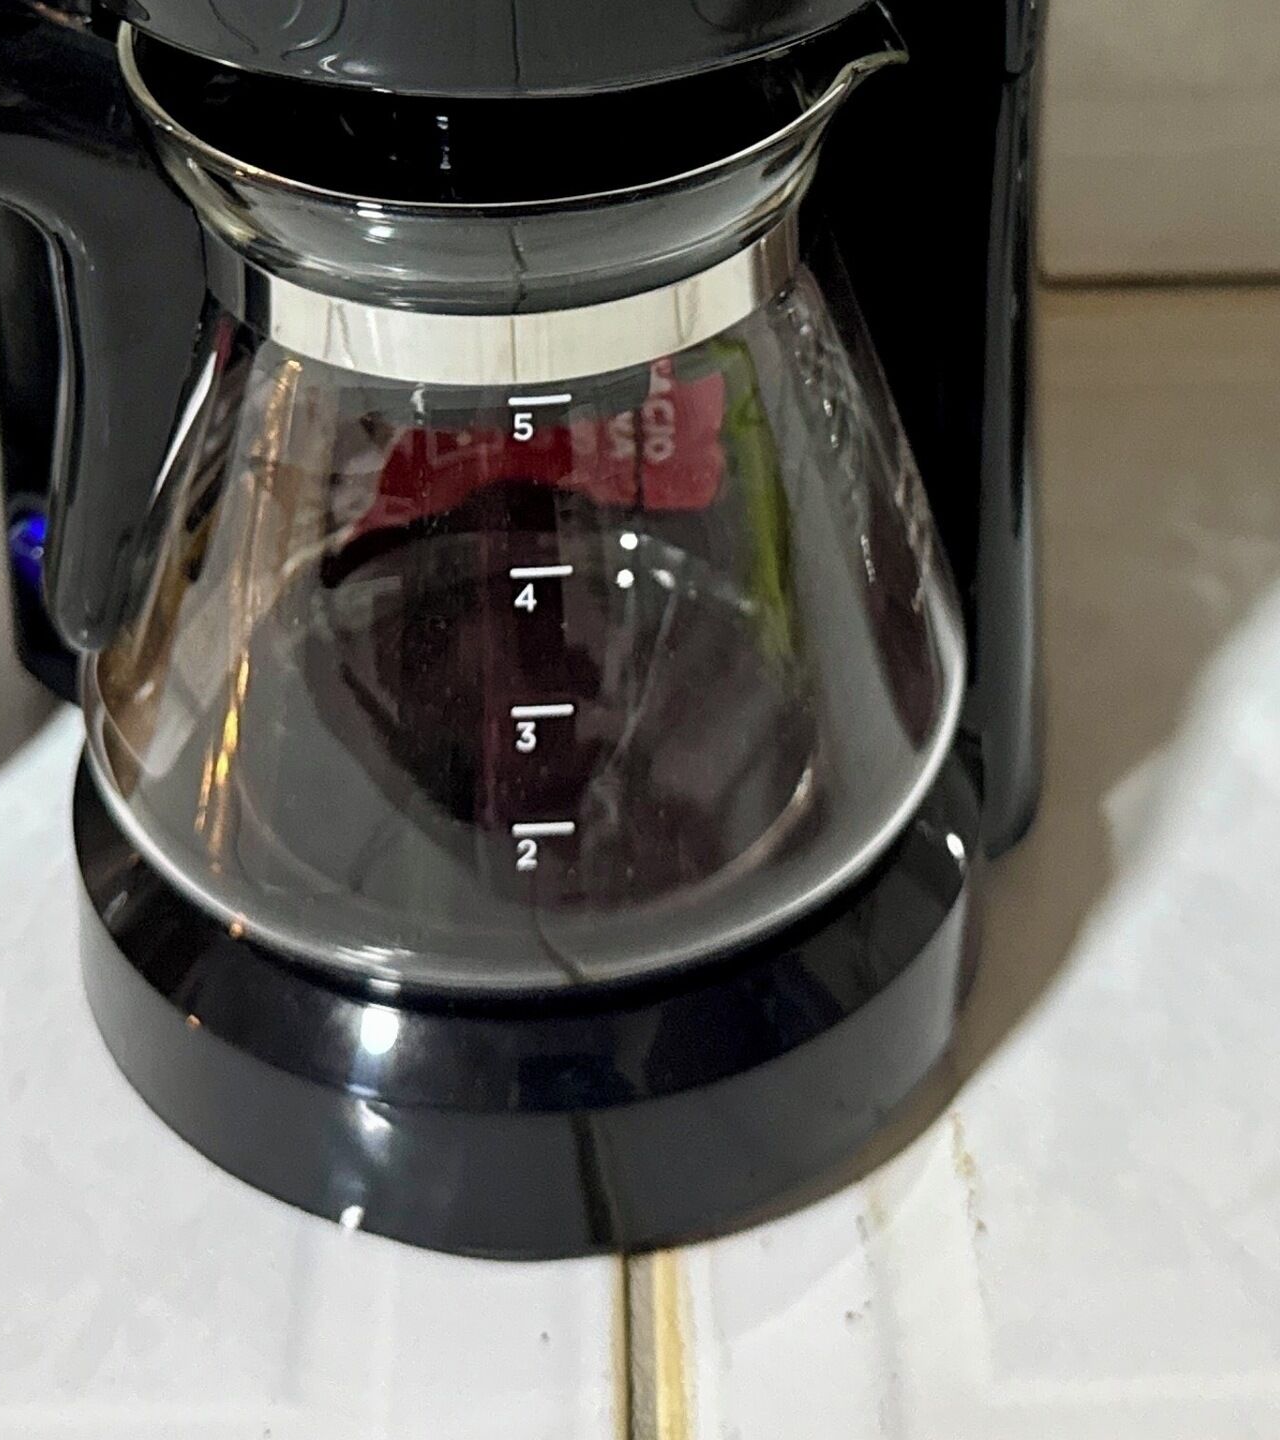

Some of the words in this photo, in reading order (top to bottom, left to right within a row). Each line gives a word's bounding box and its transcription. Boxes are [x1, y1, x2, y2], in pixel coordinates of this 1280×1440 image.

[512, 413, 534, 442] 5
[514, 585, 538, 613] 4
[515, 721, 538, 753] 3
[516, 840, 538, 871] 2
